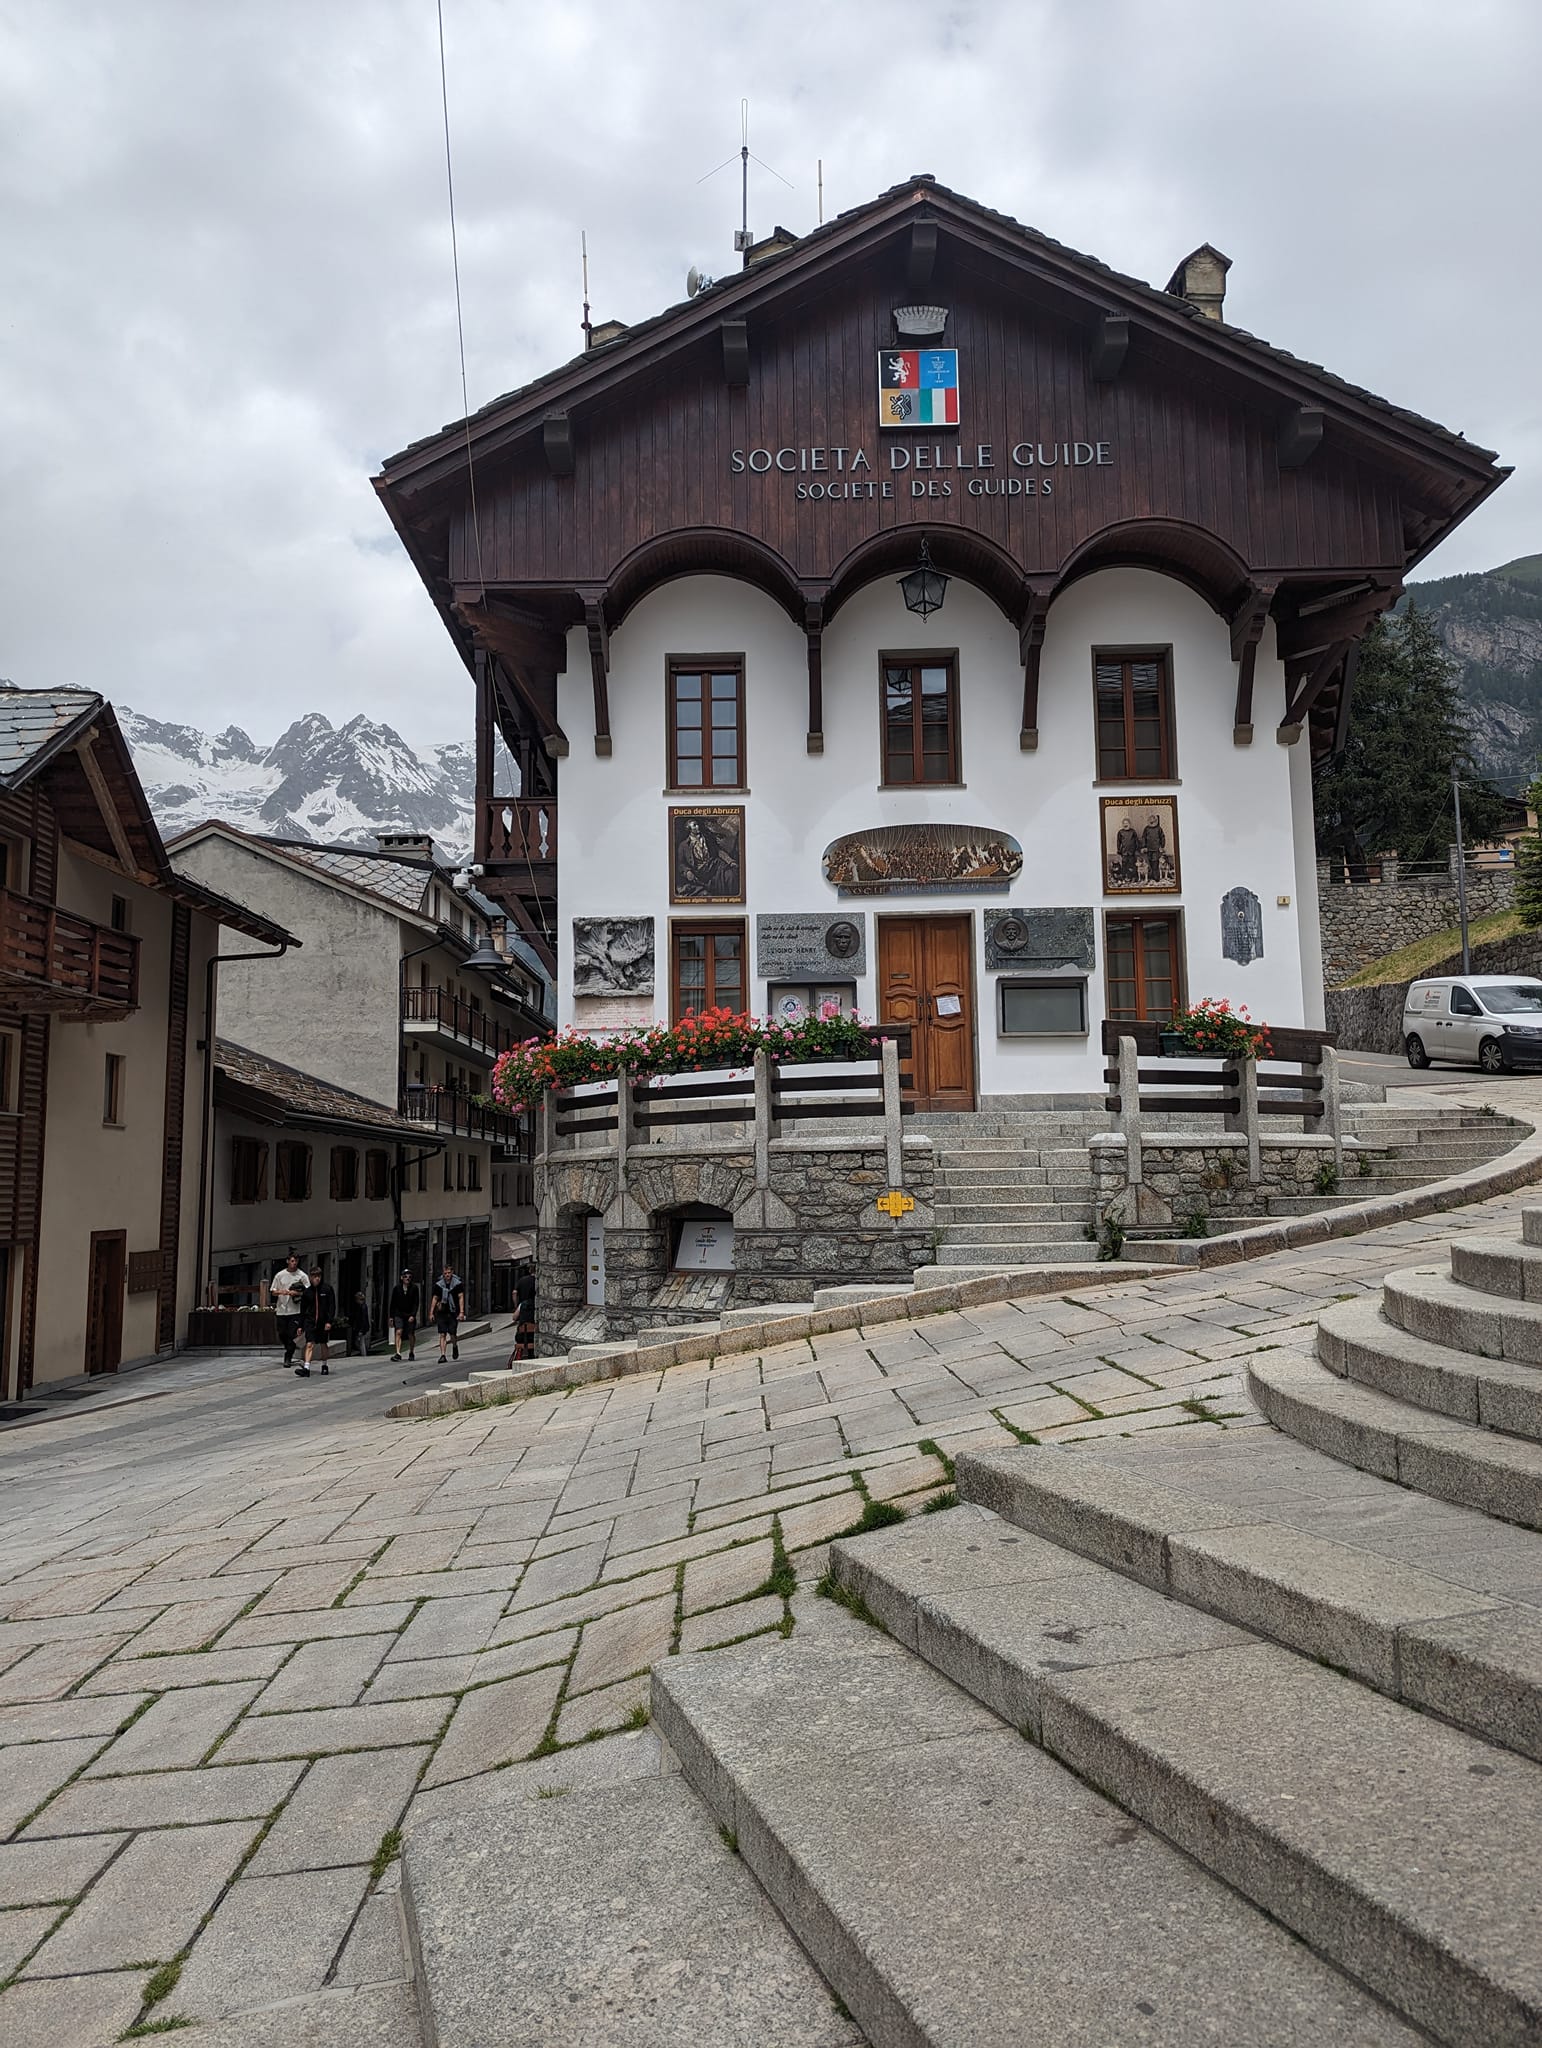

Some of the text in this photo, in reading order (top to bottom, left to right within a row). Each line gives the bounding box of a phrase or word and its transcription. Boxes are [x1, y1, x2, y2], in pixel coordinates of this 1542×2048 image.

[731, 441, 1115, 473] SOCIETA DELLE GUIDE
[797, 478, 1053, 500] SOCIETE DES GUIDES
[1125, 798, 1143, 807] degli
[673, 807, 740, 816] Duca degli Abruzzi
